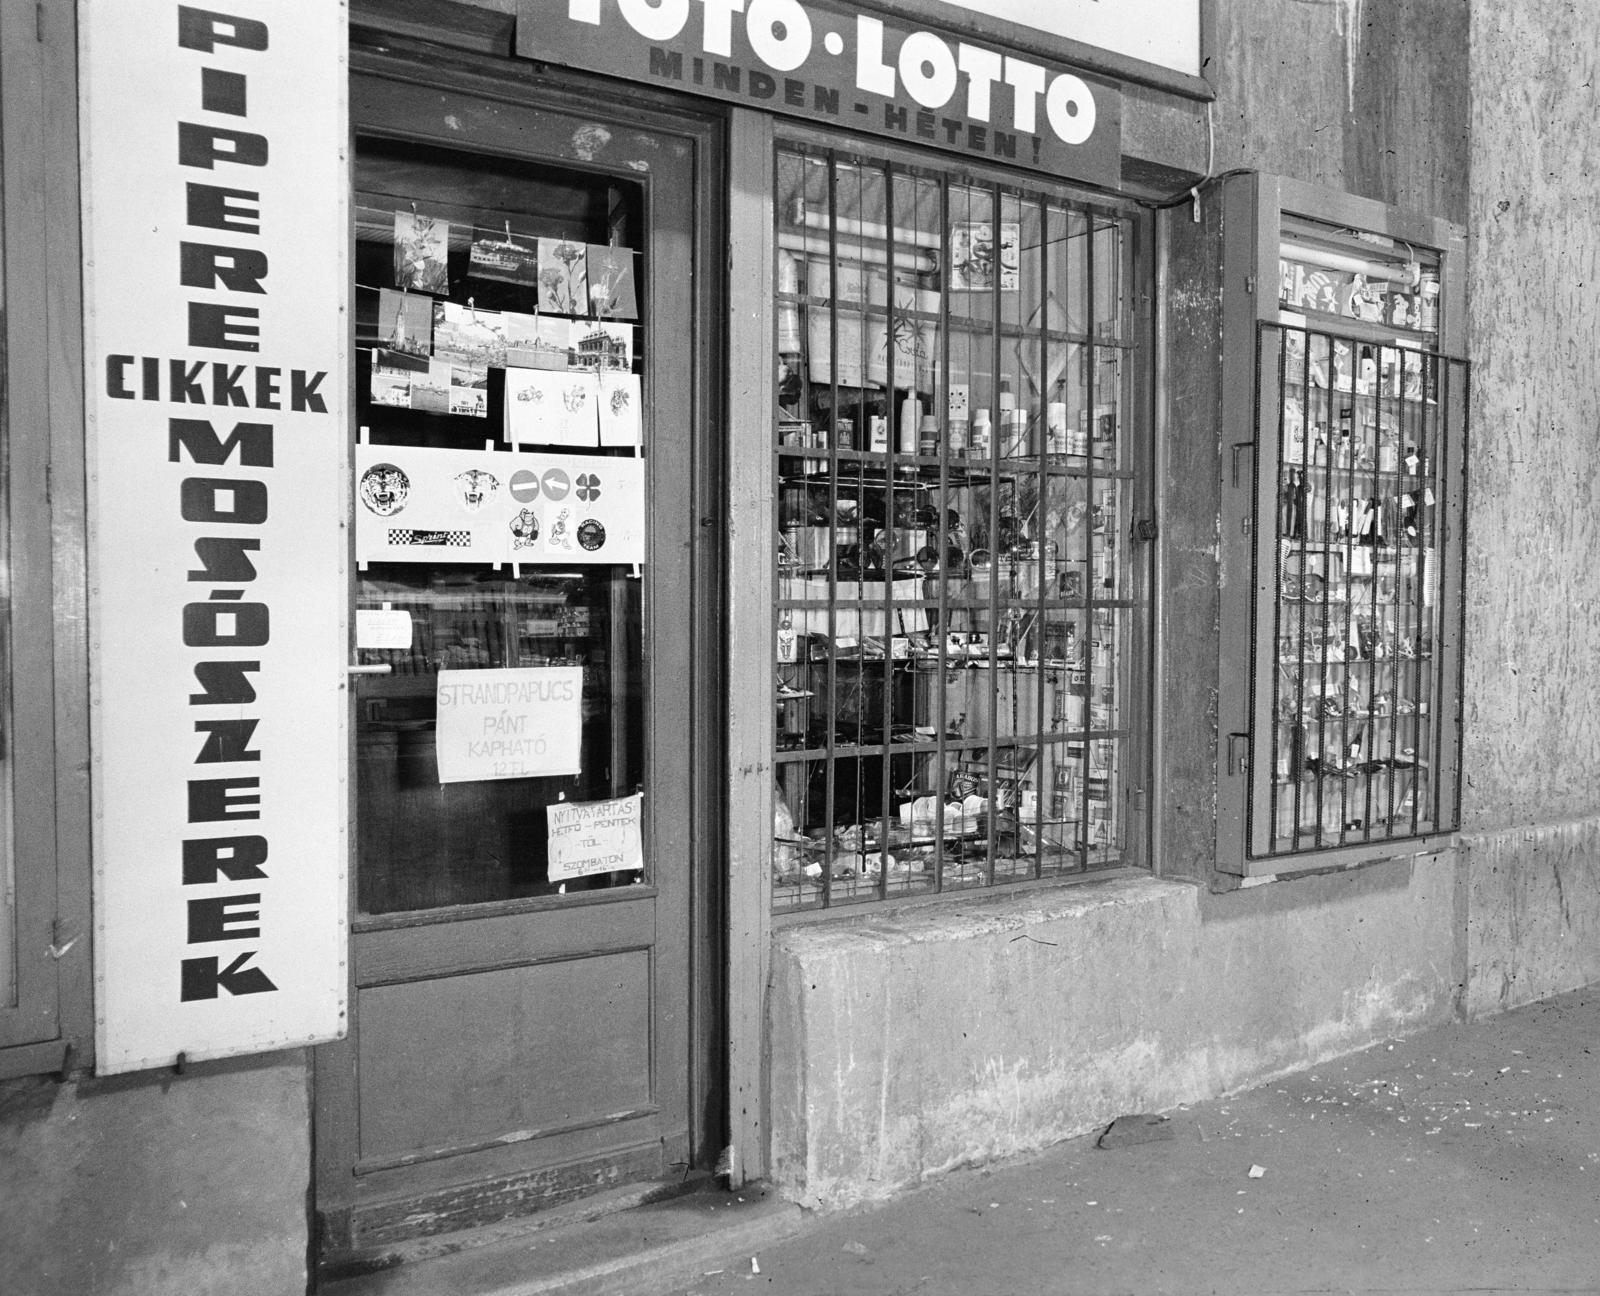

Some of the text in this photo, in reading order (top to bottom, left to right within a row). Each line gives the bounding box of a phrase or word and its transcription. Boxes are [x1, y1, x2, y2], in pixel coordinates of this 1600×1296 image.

[569, 0, 813, 71] OTO
[177, 4, 269, 352] PIPERE
[106, 354, 329, 414] CIKKEK
[411, 531, 449, 545] Sprint
[438, 679, 574, 706] STRANDPAPUCS
[167, 417, 279, 1002] MOSÓSZEREK
[483, 709, 529, 736] PÁNT
[468, 733, 548, 758] KAPHATÓ
[563, 853, 624, 871] SZOMBATON
